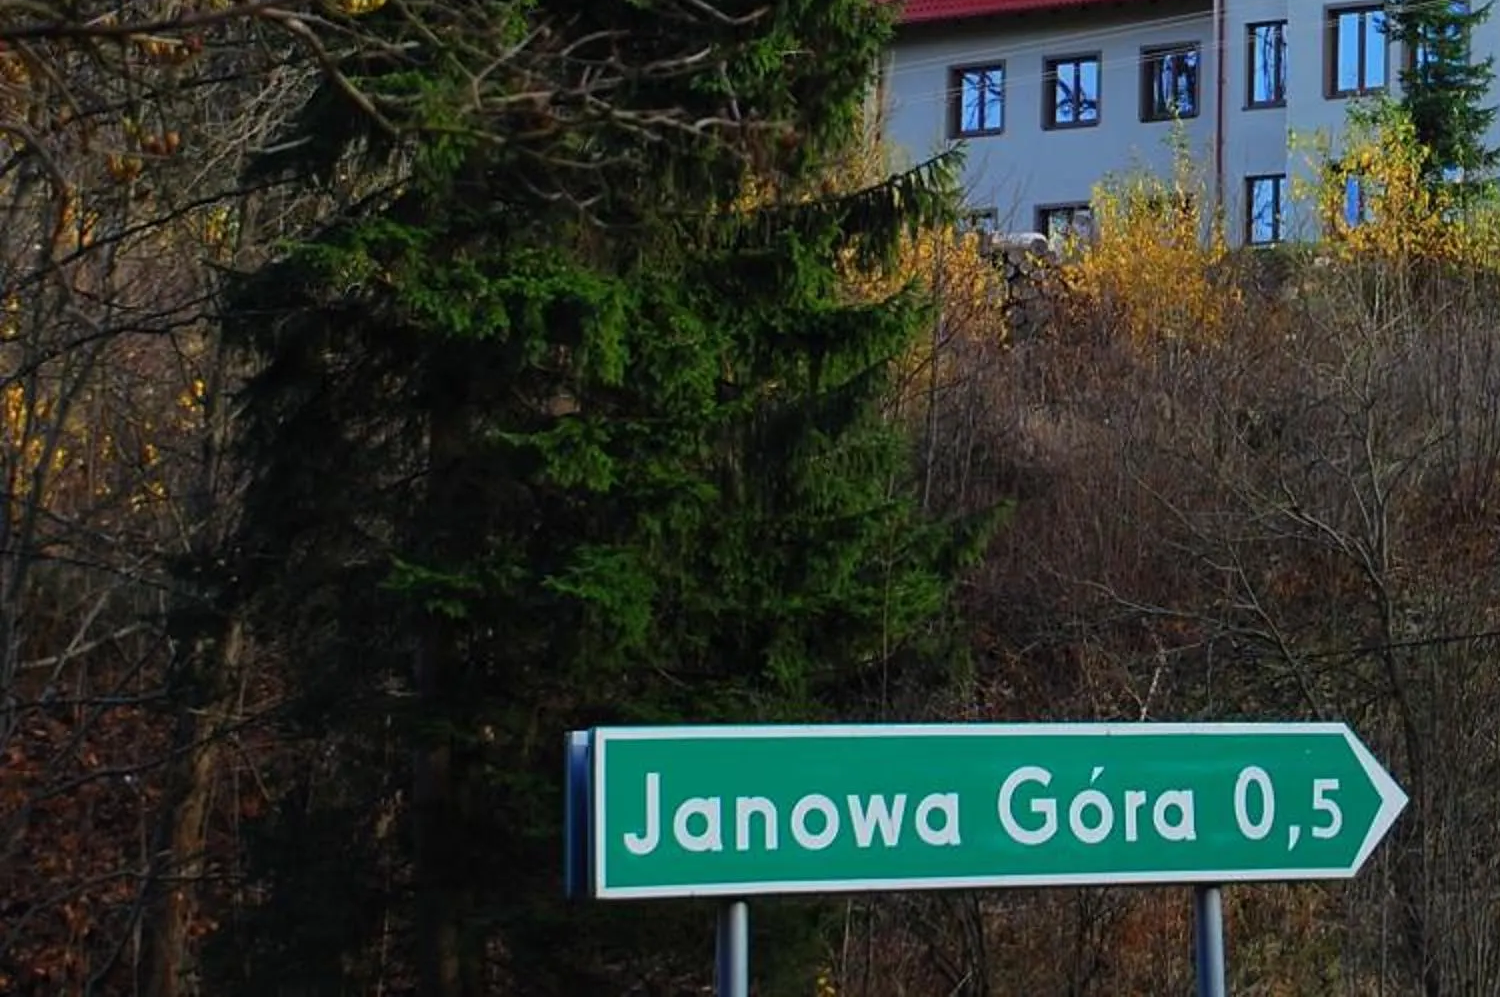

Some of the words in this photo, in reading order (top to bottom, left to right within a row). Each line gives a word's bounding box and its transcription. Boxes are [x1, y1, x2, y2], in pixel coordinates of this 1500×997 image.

[624, 772, 960, 854] Janowa
[998, 766, 1197, 844] Góra
[1235, 766, 1343, 850] 0,5
